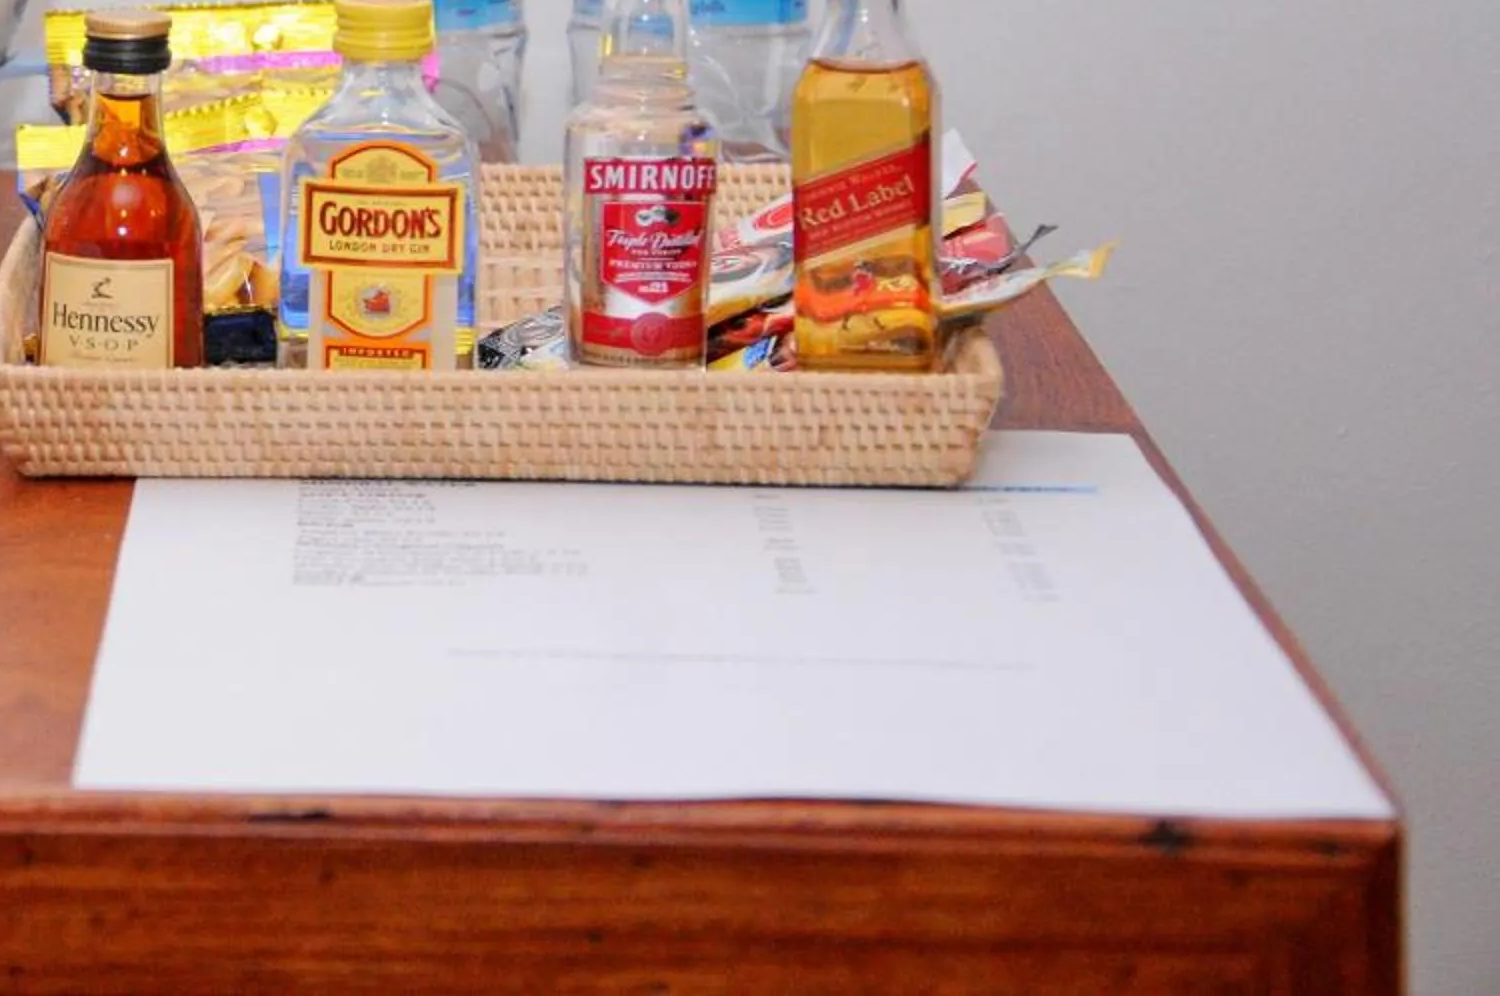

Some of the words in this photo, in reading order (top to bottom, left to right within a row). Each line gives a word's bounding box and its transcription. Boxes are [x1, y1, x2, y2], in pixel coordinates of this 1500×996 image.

[590, 164, 716, 191] SMIRNOFF
[319, 201, 442, 239] GORDON'S
[800, 198, 847, 231] Red
[847, 172, 915, 213] Label
[329, 240, 377, 253] LONDON
[52, 301, 160, 339] Hennessy
